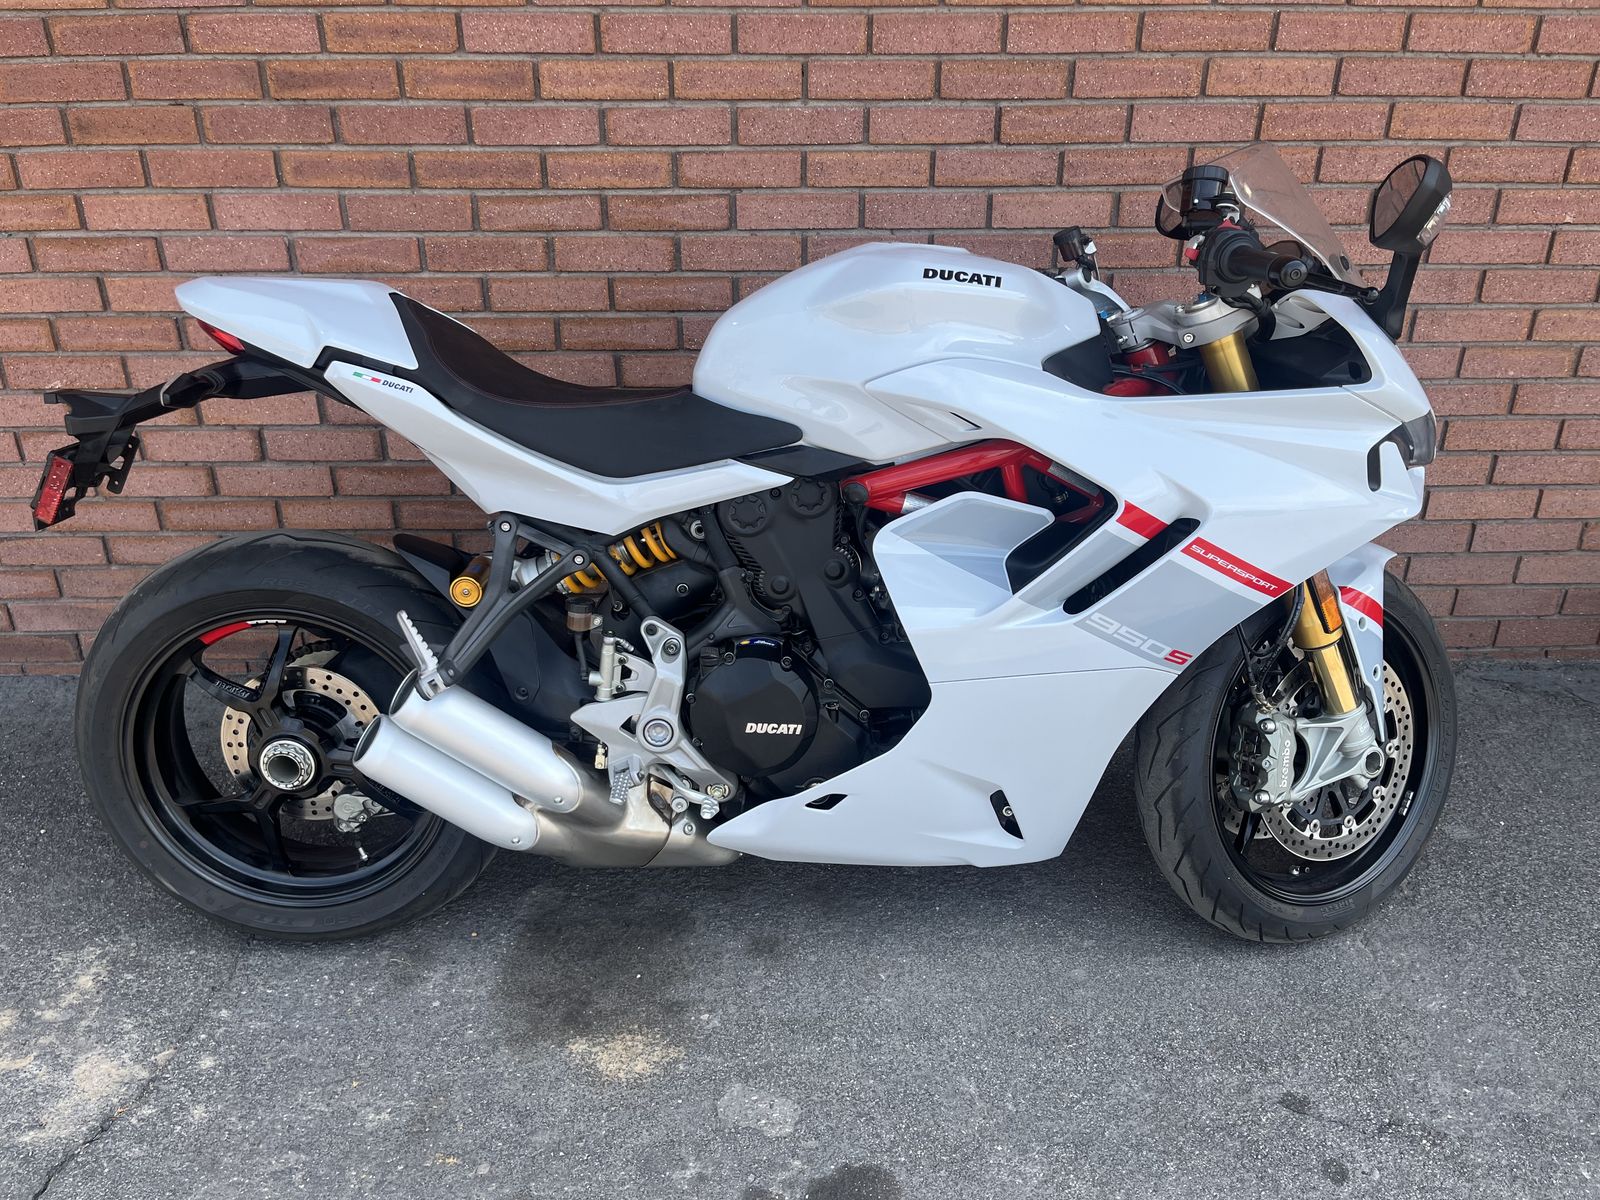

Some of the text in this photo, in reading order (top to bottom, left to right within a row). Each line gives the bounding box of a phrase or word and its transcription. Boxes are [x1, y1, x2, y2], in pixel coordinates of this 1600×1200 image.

[922, 268, 1002, 288] DUCATI
[381, 380, 414, 393] DUCATI
[1190, 544, 1278, 591] SUPERSPORT
[745, 722, 803, 735] DUCATI
[1279, 739, 1291, 788] brembo
